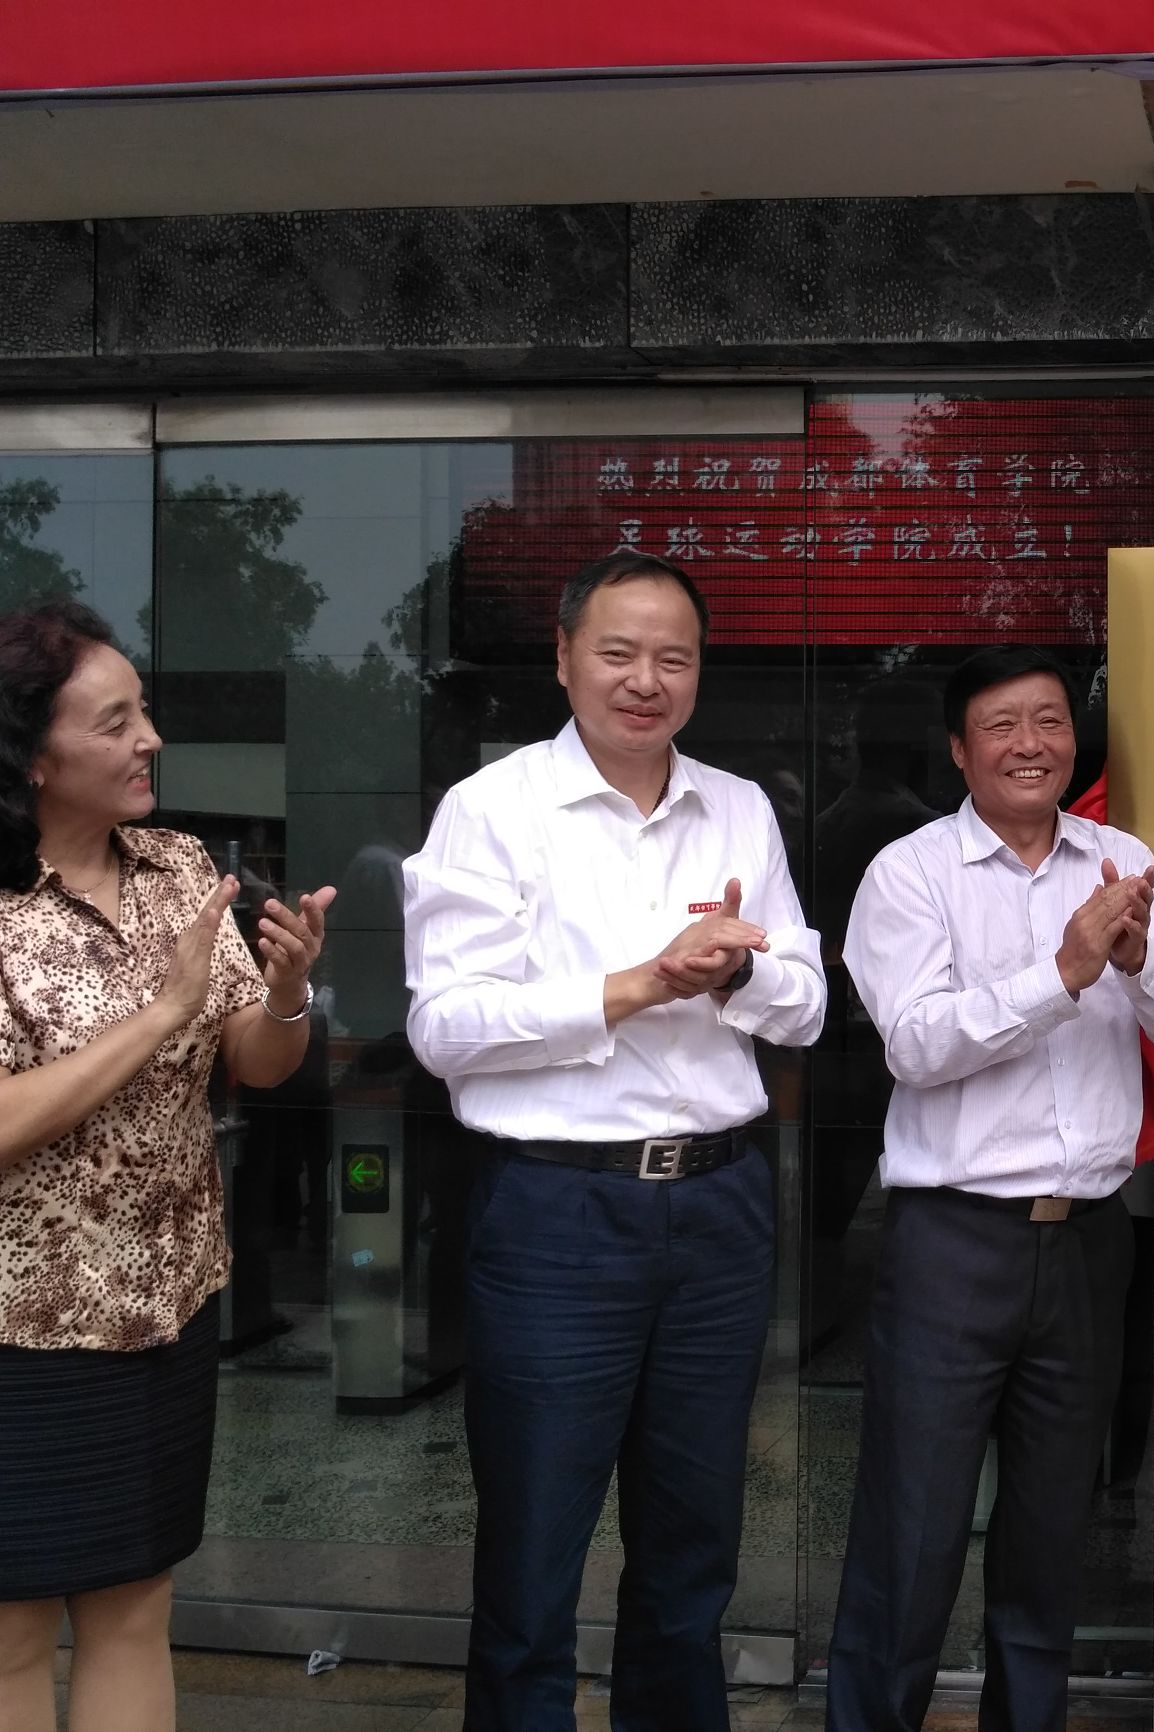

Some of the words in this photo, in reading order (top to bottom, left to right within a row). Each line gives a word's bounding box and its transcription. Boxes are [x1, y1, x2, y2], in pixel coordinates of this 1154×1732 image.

[597, 453, 1091, 498] 热烈祝贺成都体育学院
